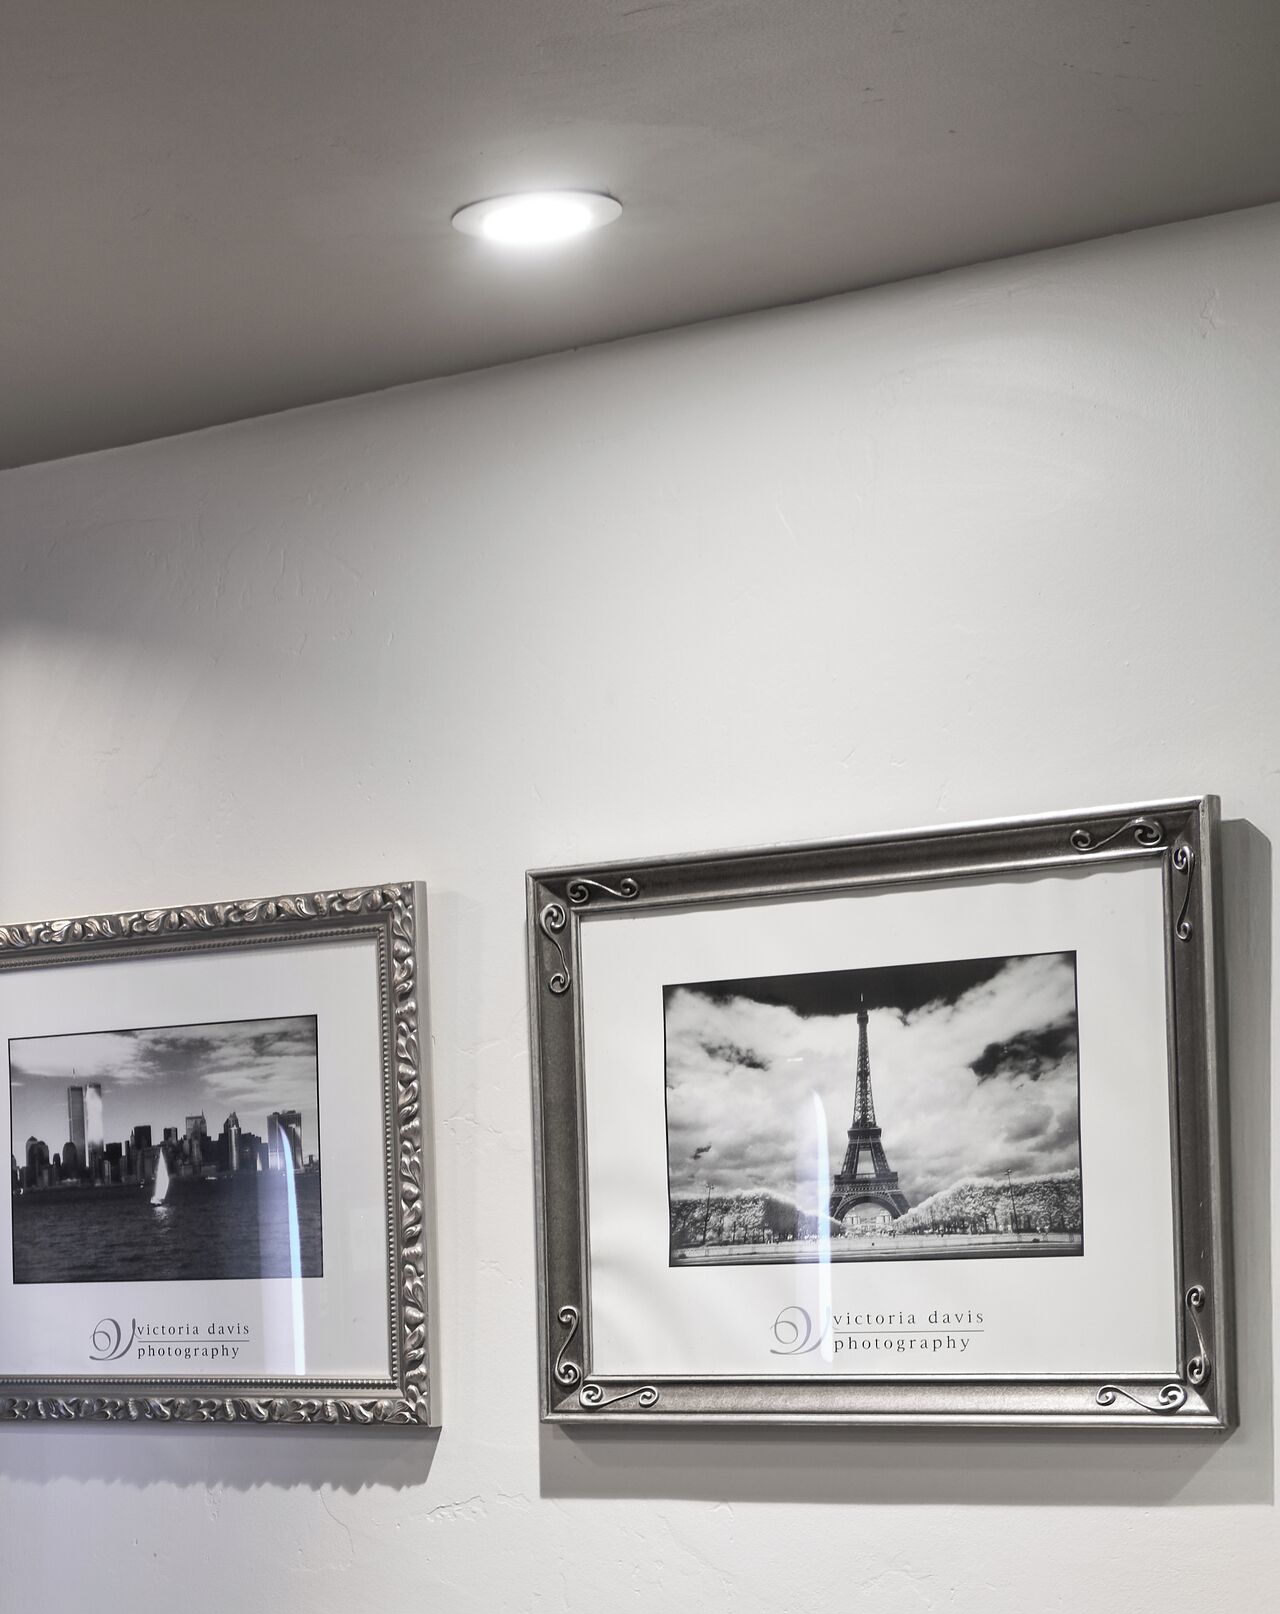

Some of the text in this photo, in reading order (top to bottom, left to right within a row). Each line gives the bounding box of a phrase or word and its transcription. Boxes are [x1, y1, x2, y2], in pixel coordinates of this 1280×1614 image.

[833, 1310, 984, 1325] victoria davis
[137, 1322, 250, 1335] victoria davis
[834, 1335, 970, 1352] photography
[137, 1344, 240, 1360] photography
